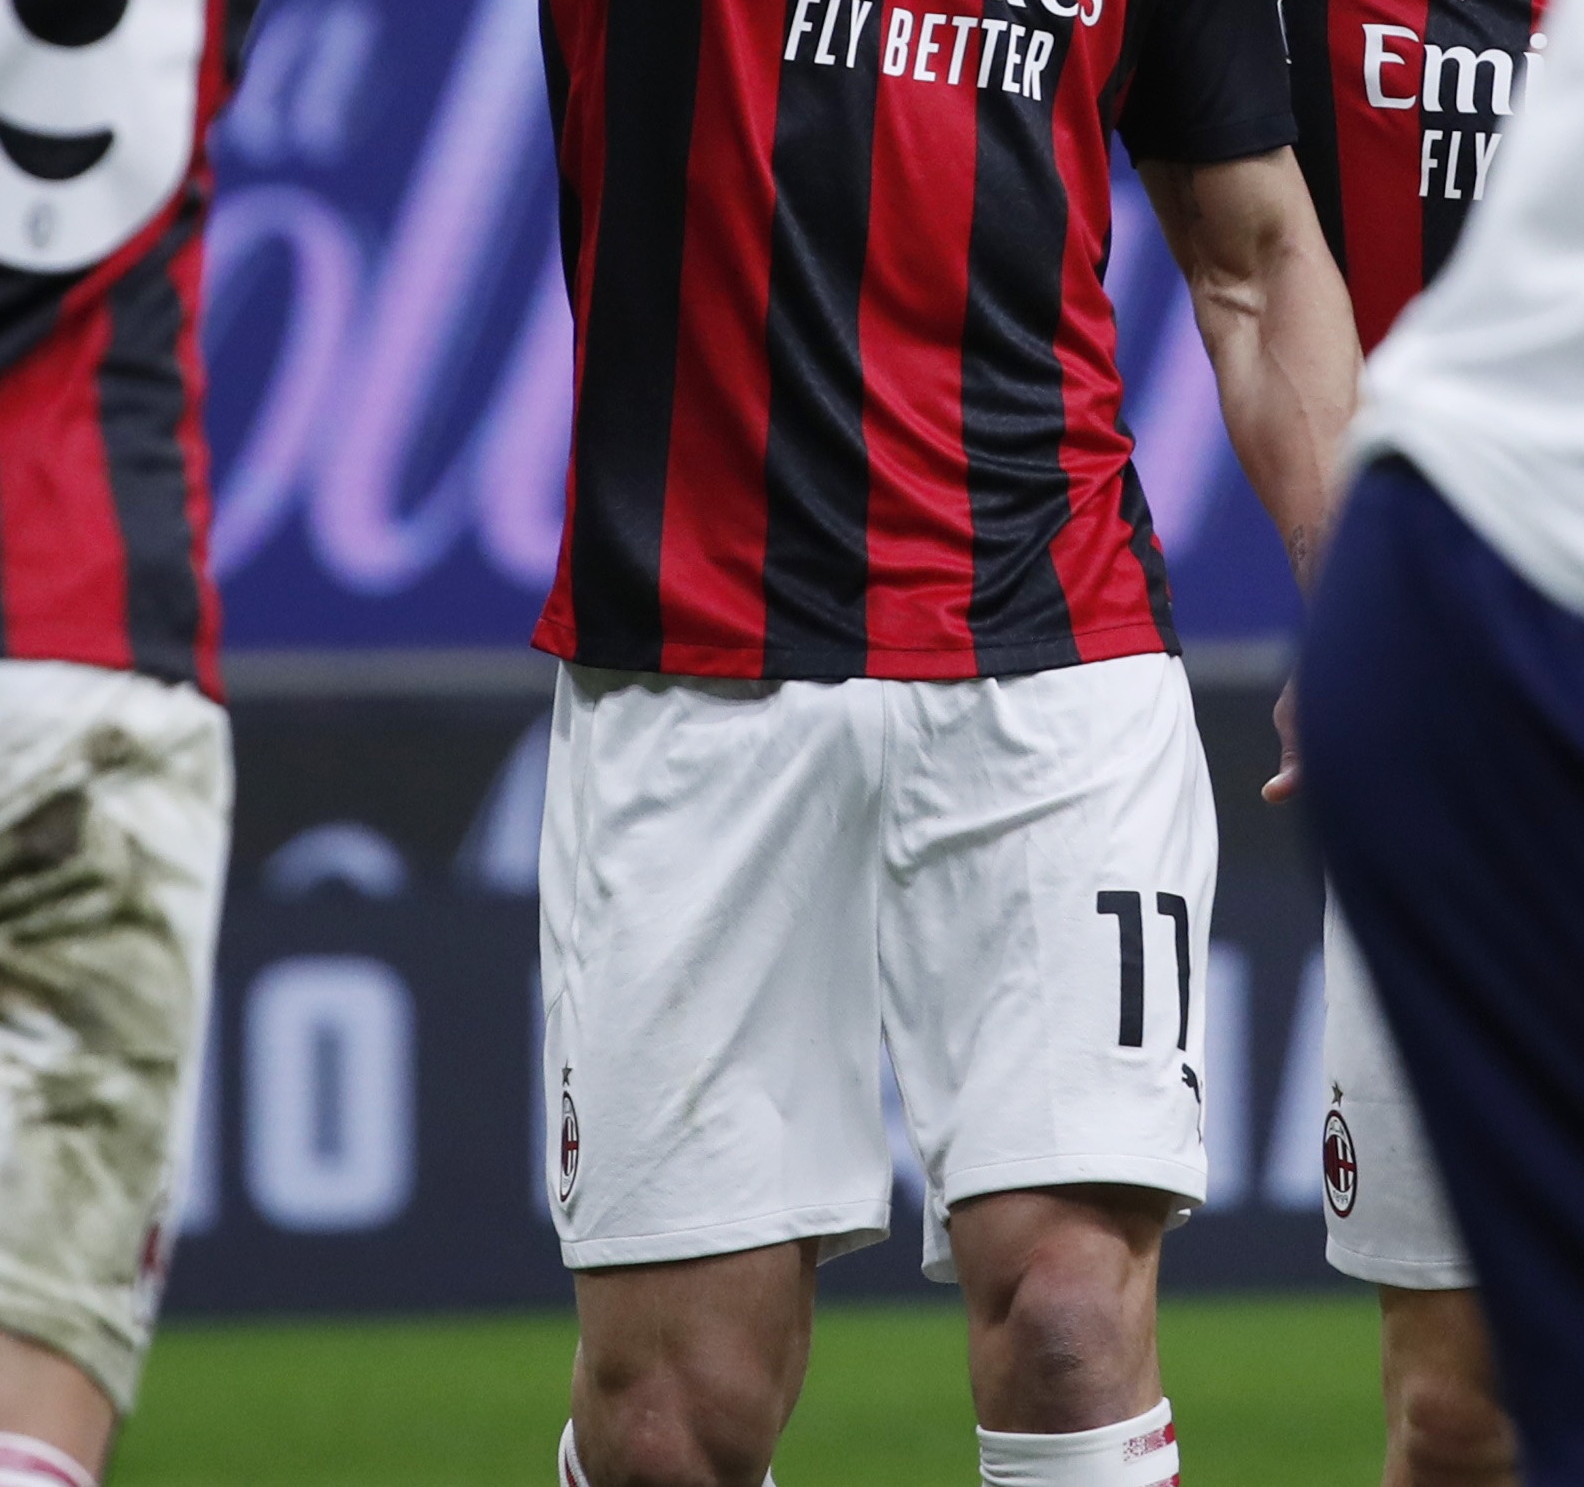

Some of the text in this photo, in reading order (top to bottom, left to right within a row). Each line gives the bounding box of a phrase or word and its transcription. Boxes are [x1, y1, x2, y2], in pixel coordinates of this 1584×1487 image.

[883, 7, 1056, 102] BETTER
[1418, 129, 1503, 201] FLY
[1096, 890, 1191, 1052] 11
